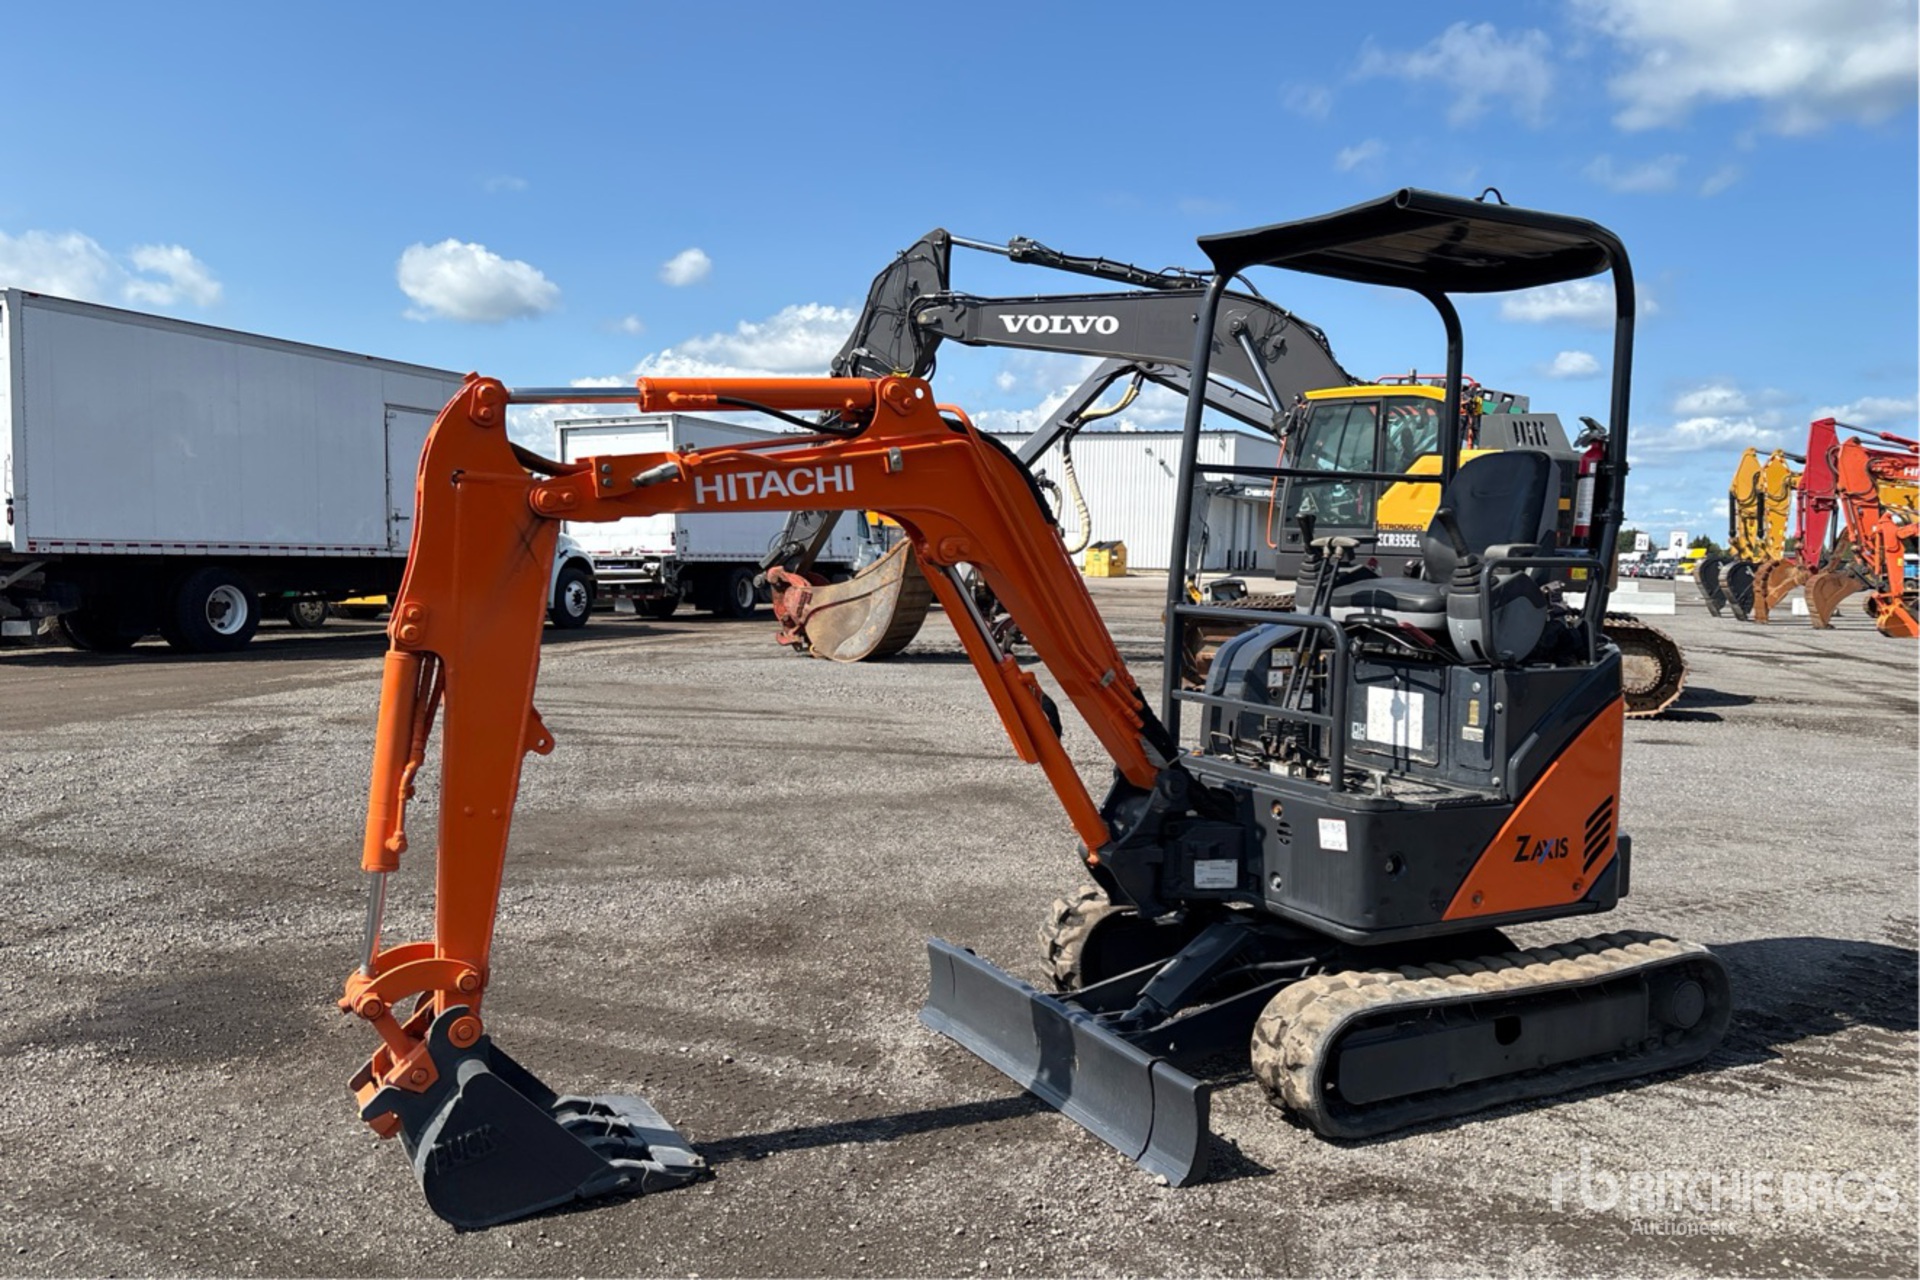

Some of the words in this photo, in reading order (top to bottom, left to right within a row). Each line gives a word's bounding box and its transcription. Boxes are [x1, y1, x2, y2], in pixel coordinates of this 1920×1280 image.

[998, 314, 1120, 335] VOLVO
[694, 464, 855, 504] HITACHI
[1637, 538, 1647, 547] 21
[1674, 537, 1683, 547] 4
